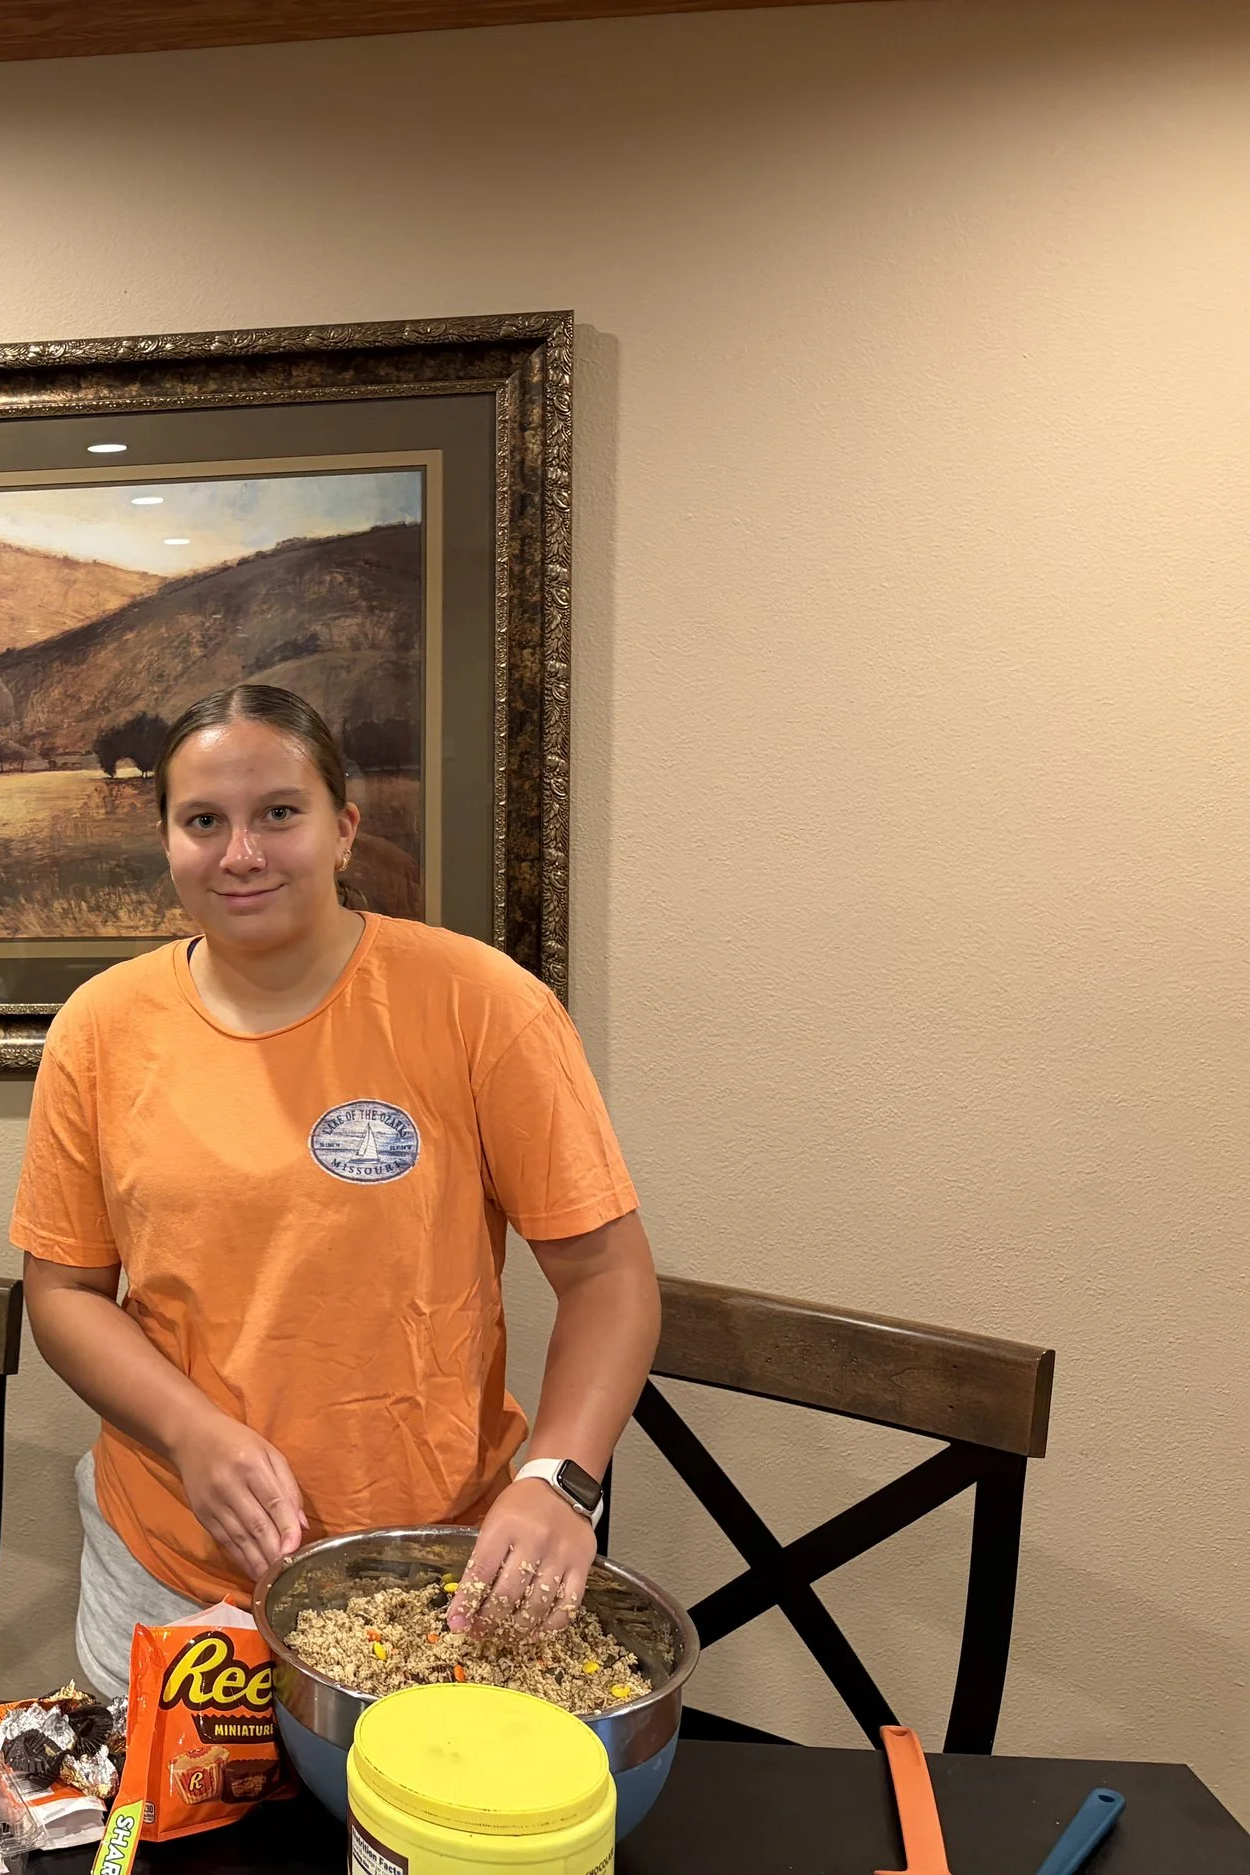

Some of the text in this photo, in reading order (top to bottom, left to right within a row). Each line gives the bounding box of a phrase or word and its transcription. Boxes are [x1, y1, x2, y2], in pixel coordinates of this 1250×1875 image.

[322, 1109, 411, 1137] LAKE OF THE OZARKS
[331, 1158, 401, 1175] MISSOURI
[189, 1771, 204, 1791] R
